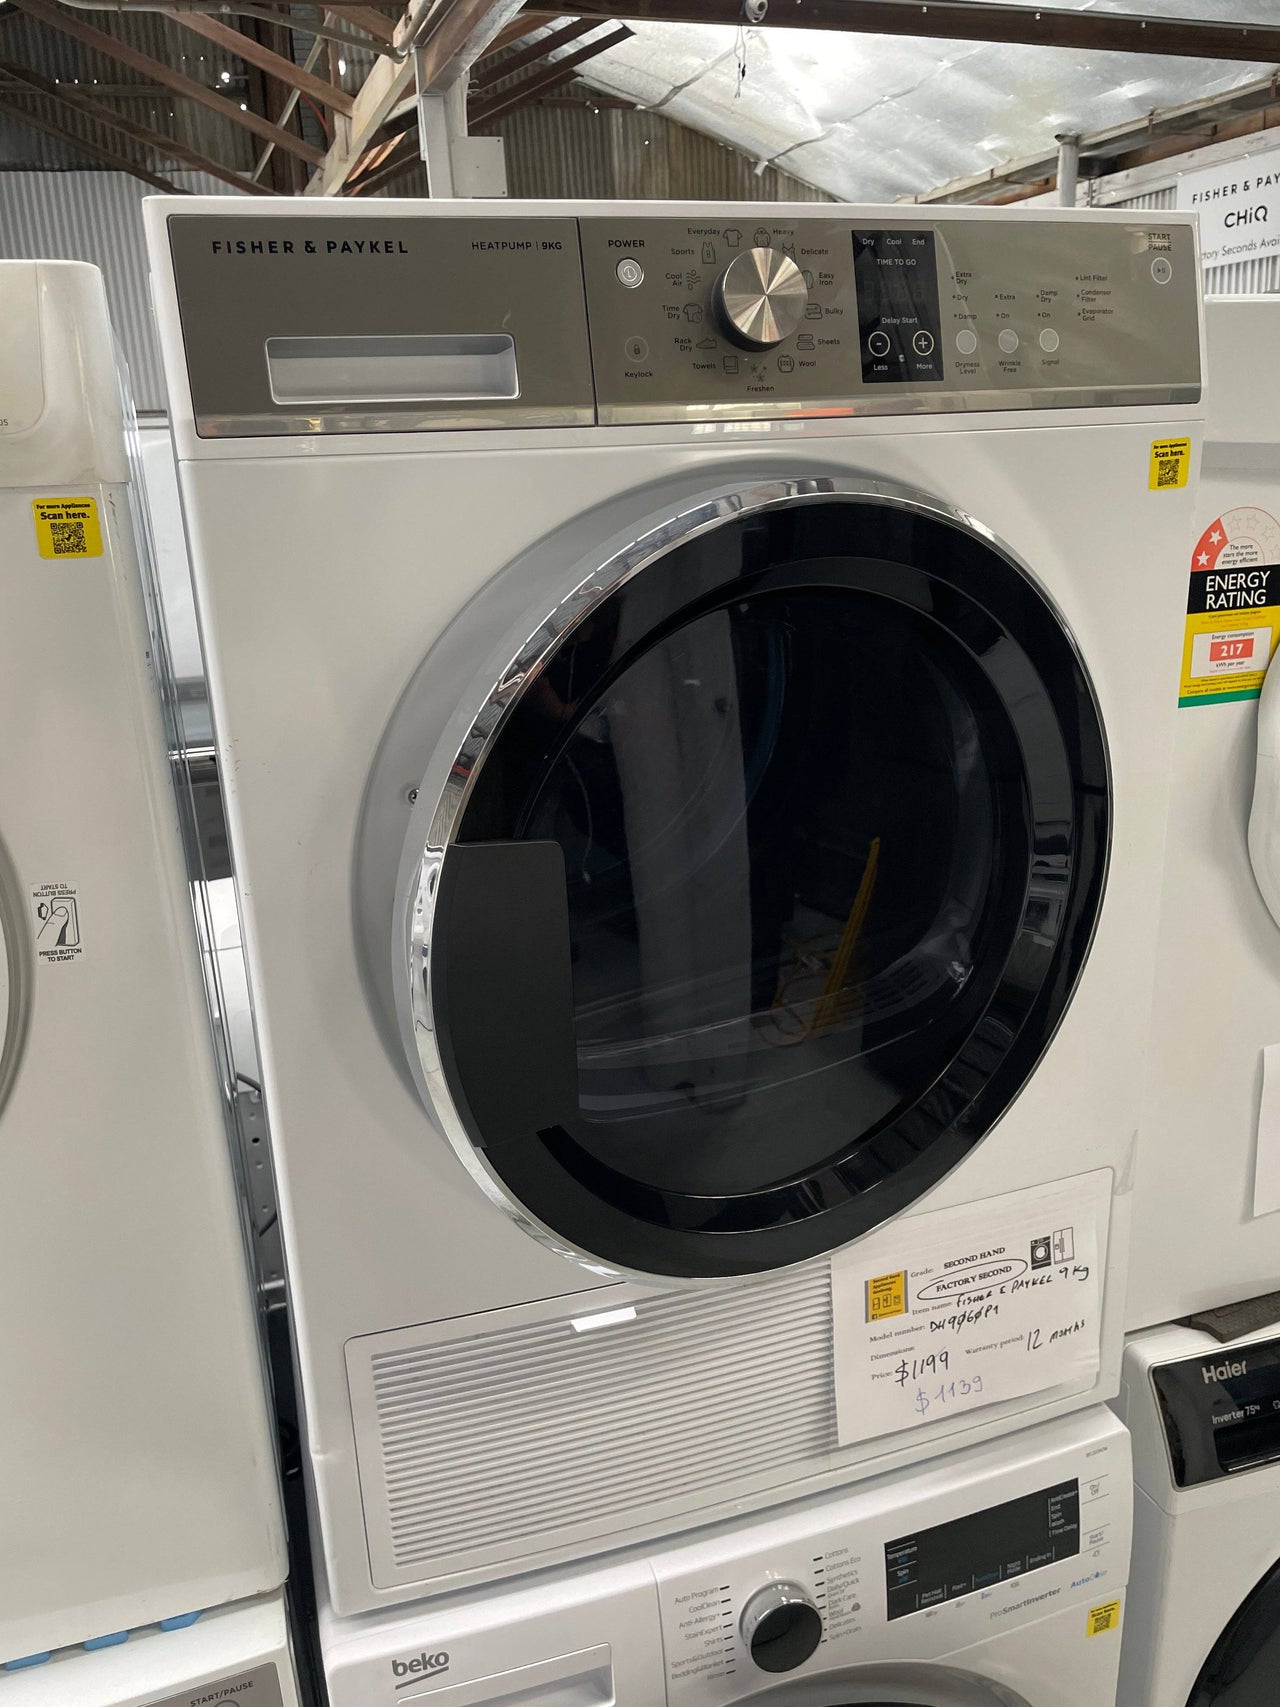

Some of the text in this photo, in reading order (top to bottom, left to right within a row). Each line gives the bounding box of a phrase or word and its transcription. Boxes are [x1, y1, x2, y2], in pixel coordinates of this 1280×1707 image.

[1192, 184, 1237, 204] FISHER
[1243, 181, 1250, 191] &
[687, 228, 721, 236] Everyday
[773, 228, 794, 236] Heavy
[1148, 233, 1171, 241] START
[212, 240, 408, 254] FISHER & PAYKEL
[471, 241, 562, 251] HEATPUMP 9KG
[608, 240, 645, 248] POWER
[862, 238, 875, 247] Dry
[886, 238, 902, 246] Cool
[912, 238, 925, 246] End
[1222, 238, 1257, 257] Seconds
[671, 248, 695, 256] Sports
[876, 258, 917, 266] TIME TO GO
[819, 272, 834, 280] Easy
[956, 278, 967, 286] Dry
[957, 294, 969, 302] Dry
[1041, 296, 1052, 304] Dry
[667, 312, 681, 320] Dry
[881, 317, 900, 325] Delay
[817, 338, 841, 346] Sheets
[679, 344, 693, 352] Dry
[40, 510, 90, 520] Scan here.
[1206, 570, 1271, 592] ENERGY
[1206, 588, 1267, 610] RATING
[1220, 643, 1244, 657] 217
[943, 1247, 1006, 1270] SECOND HAND
[936, 1265, 1012, 1293] FACTORY SECOND
[869, 1324, 926, 1343] Model number:
[1026, 1328, 1044, 1351] 12
[965, 1342, 999, 1355] Warranty
[894, 1351, 949, 1388] $1199
[1201, 1360, 1247, 1384] Haier
[871, 1370, 894, 1381] Price:
[1212, 1410, 1245, 1424] Inverter
[674, 1587, 719, 1604] Auto Program
[688, 1600, 720, 1613] CoolClean
[990, 1587, 1061, 1621] ProSmartInverter
[392, 1651, 449, 1677] beko
[190, 1680, 254, 1707] START/PAUSE
